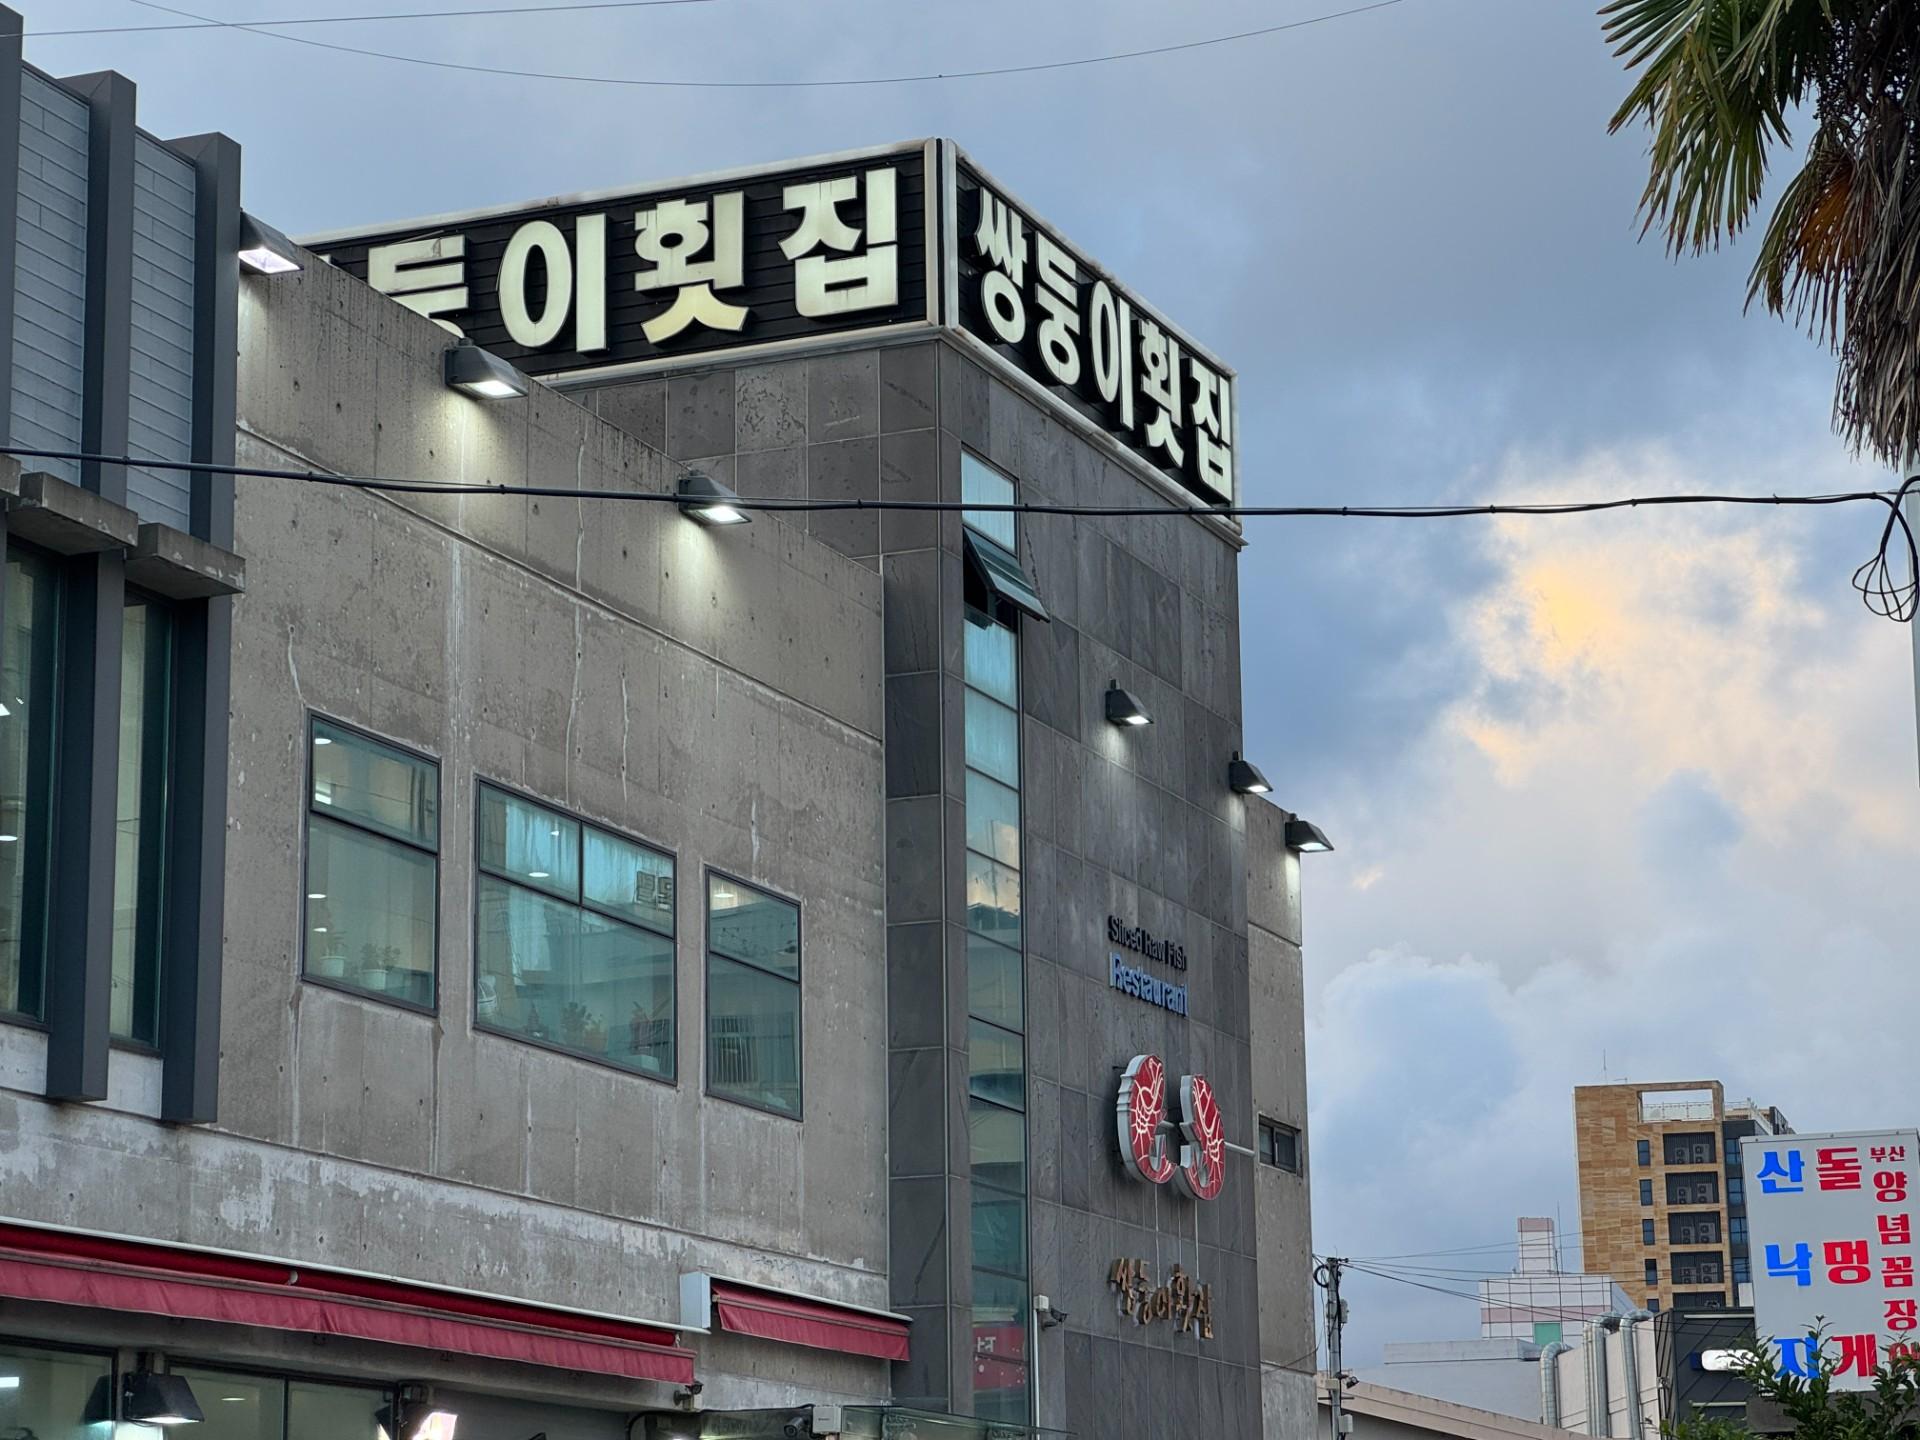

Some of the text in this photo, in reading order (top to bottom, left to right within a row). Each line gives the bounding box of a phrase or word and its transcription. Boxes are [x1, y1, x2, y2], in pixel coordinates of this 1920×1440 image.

[975, 186, 1232, 501] 쌍둥이횟집
[1107, 915, 1146, 954] Sliced
[1109, 951, 1188, 1017] Restaurant
[1870, 1146, 1905, 1163] 부산
[1757, 1150, 1820, 1379] 산낙지
[1816, 1147, 1877, 1377] 돌멍게
